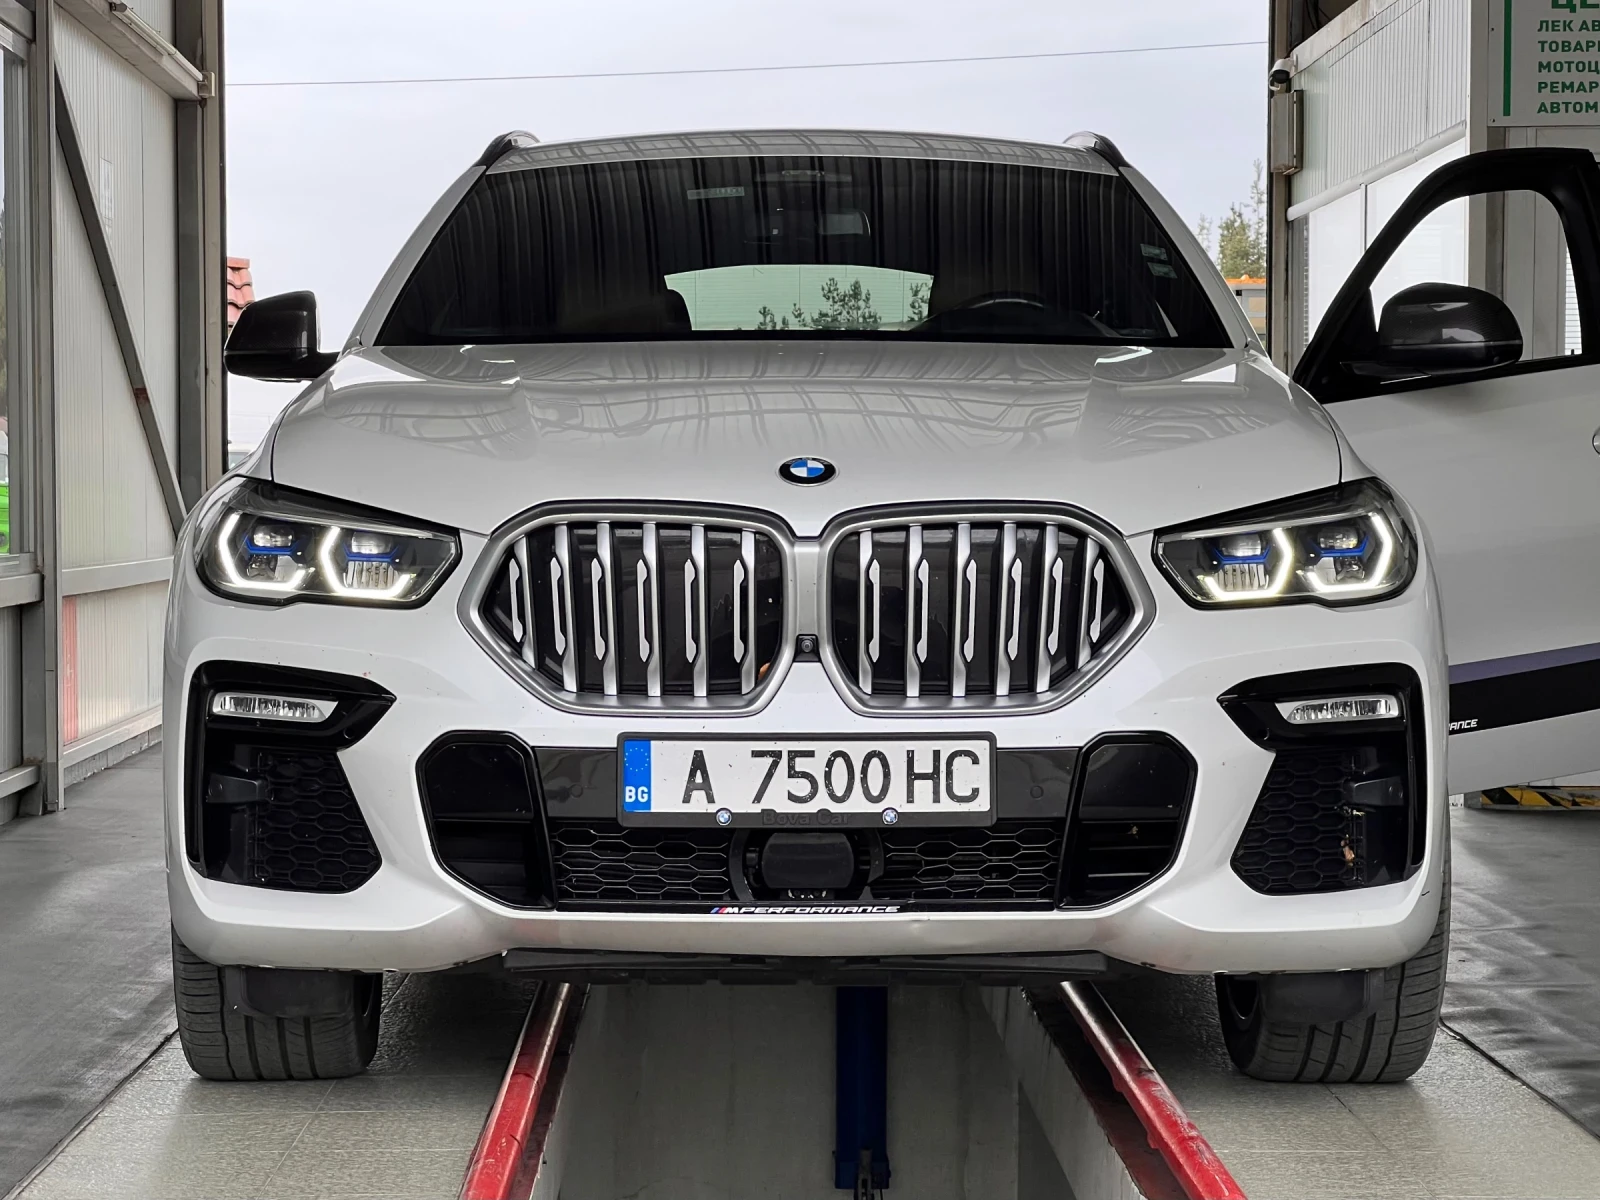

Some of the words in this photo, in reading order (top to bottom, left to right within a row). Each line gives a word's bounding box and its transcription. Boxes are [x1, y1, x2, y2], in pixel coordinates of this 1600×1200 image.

[1537, 20, 1574, 32] ЛЕК
[1537, 40, 1600, 52] ТОВАР
[1538, 61, 1600, 74] МОТОЦ
[1537, 81, 1600, 93] РЕМАР
[1537, 101, 1598, 113] АВТОМ
[1449, 719, 1478, 730] ANCE
[682, 749, 716, 804] A
[751, 749, 892, 804] 7500
[906, 749, 980, 804] HC
[625, 785, 649, 803] BG
[762, 808, 811, 825] Bova
[817, 808, 851, 825] Car
